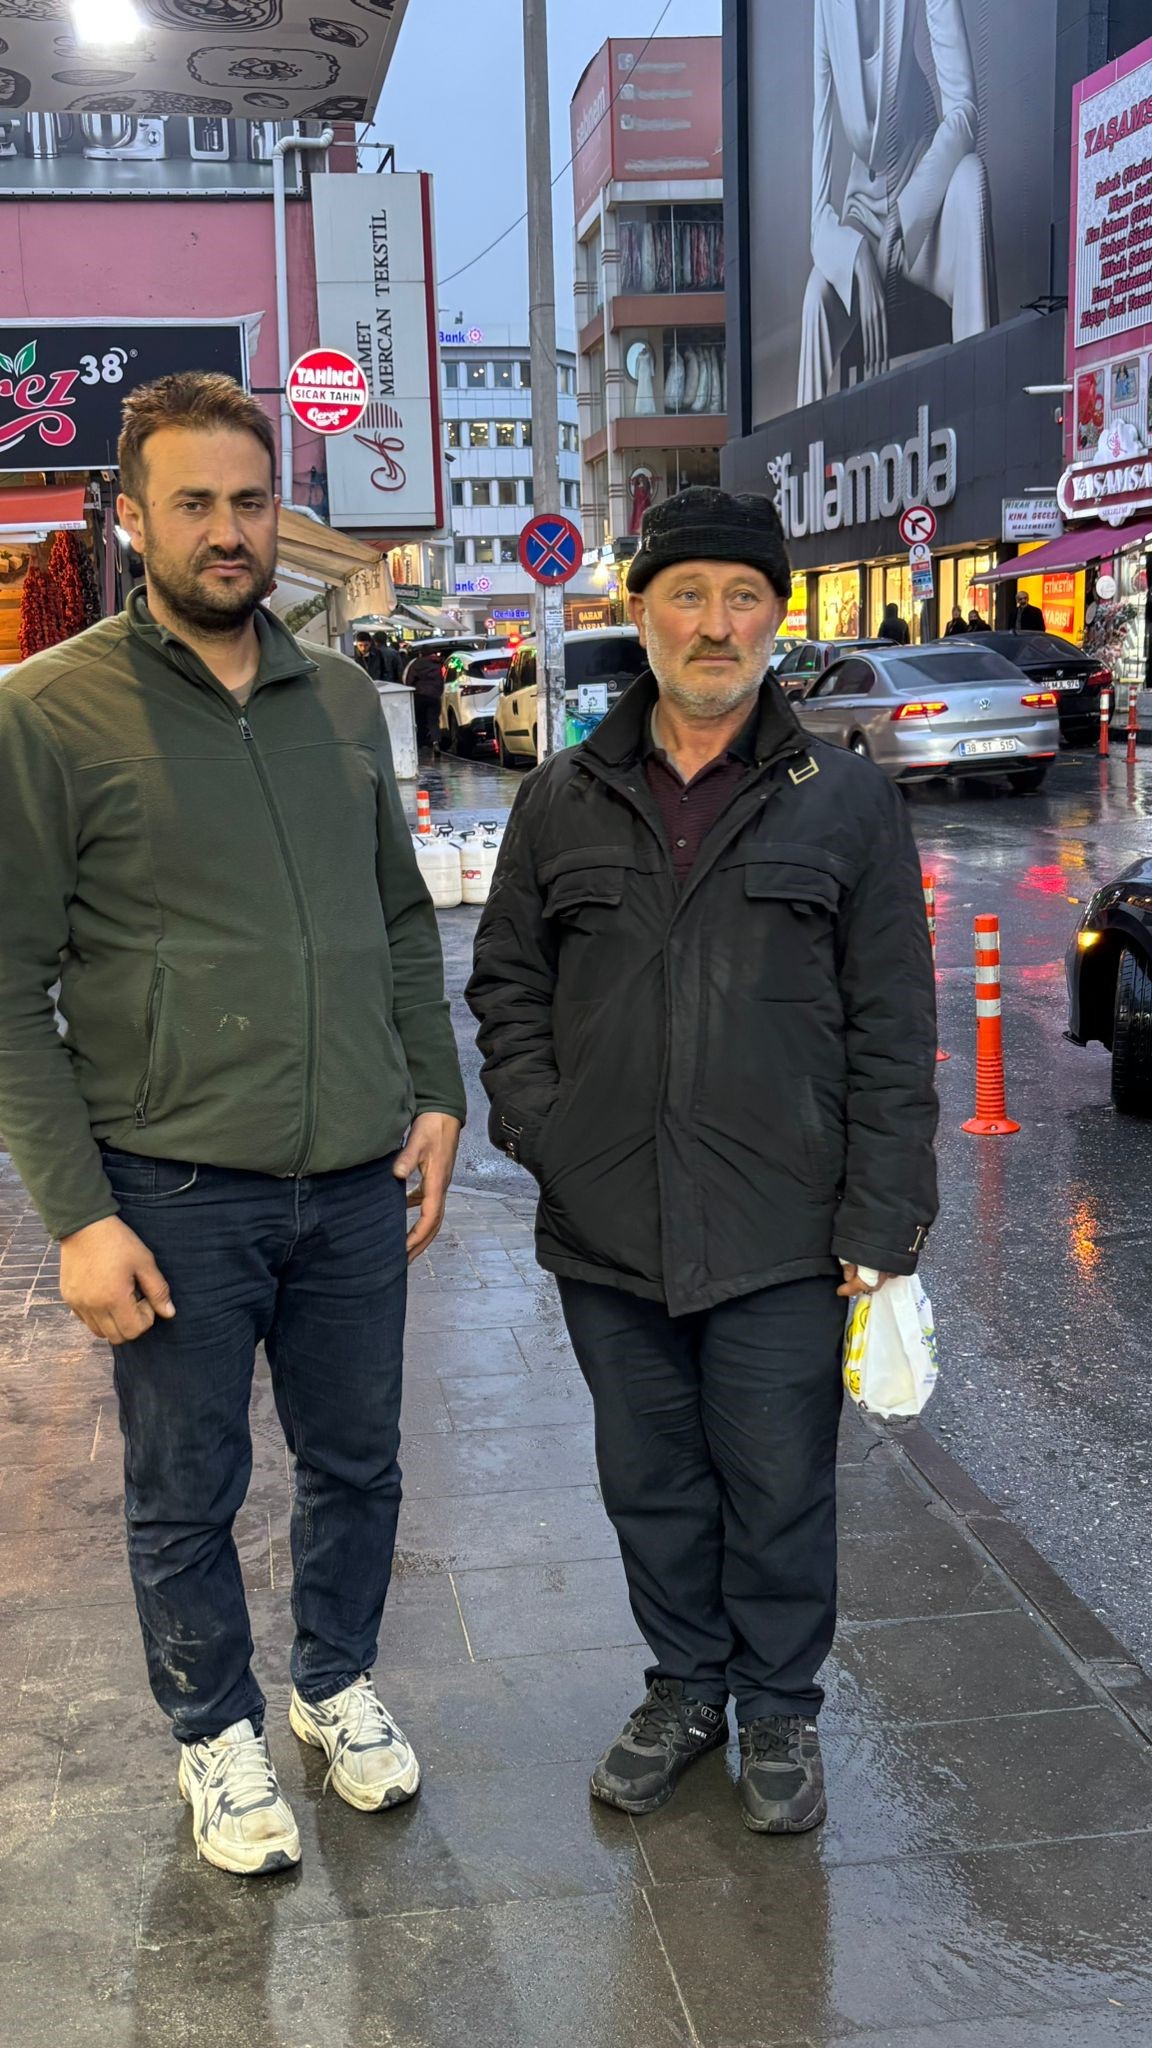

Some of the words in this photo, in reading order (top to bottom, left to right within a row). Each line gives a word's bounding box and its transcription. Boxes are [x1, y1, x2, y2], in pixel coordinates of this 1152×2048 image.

[1095, 172, 1121, 200] Bebek
[369, 208, 390, 297] TEKSTİL
[376, 308, 395, 396] MERCAN
[295, 389, 326, 400] SICAK
[780, 404, 957, 540] fullamoda
[966, 743, 977, 753] 38
[982, 742, 992, 752] ST
[1000, 740, 1014, 750] 515
